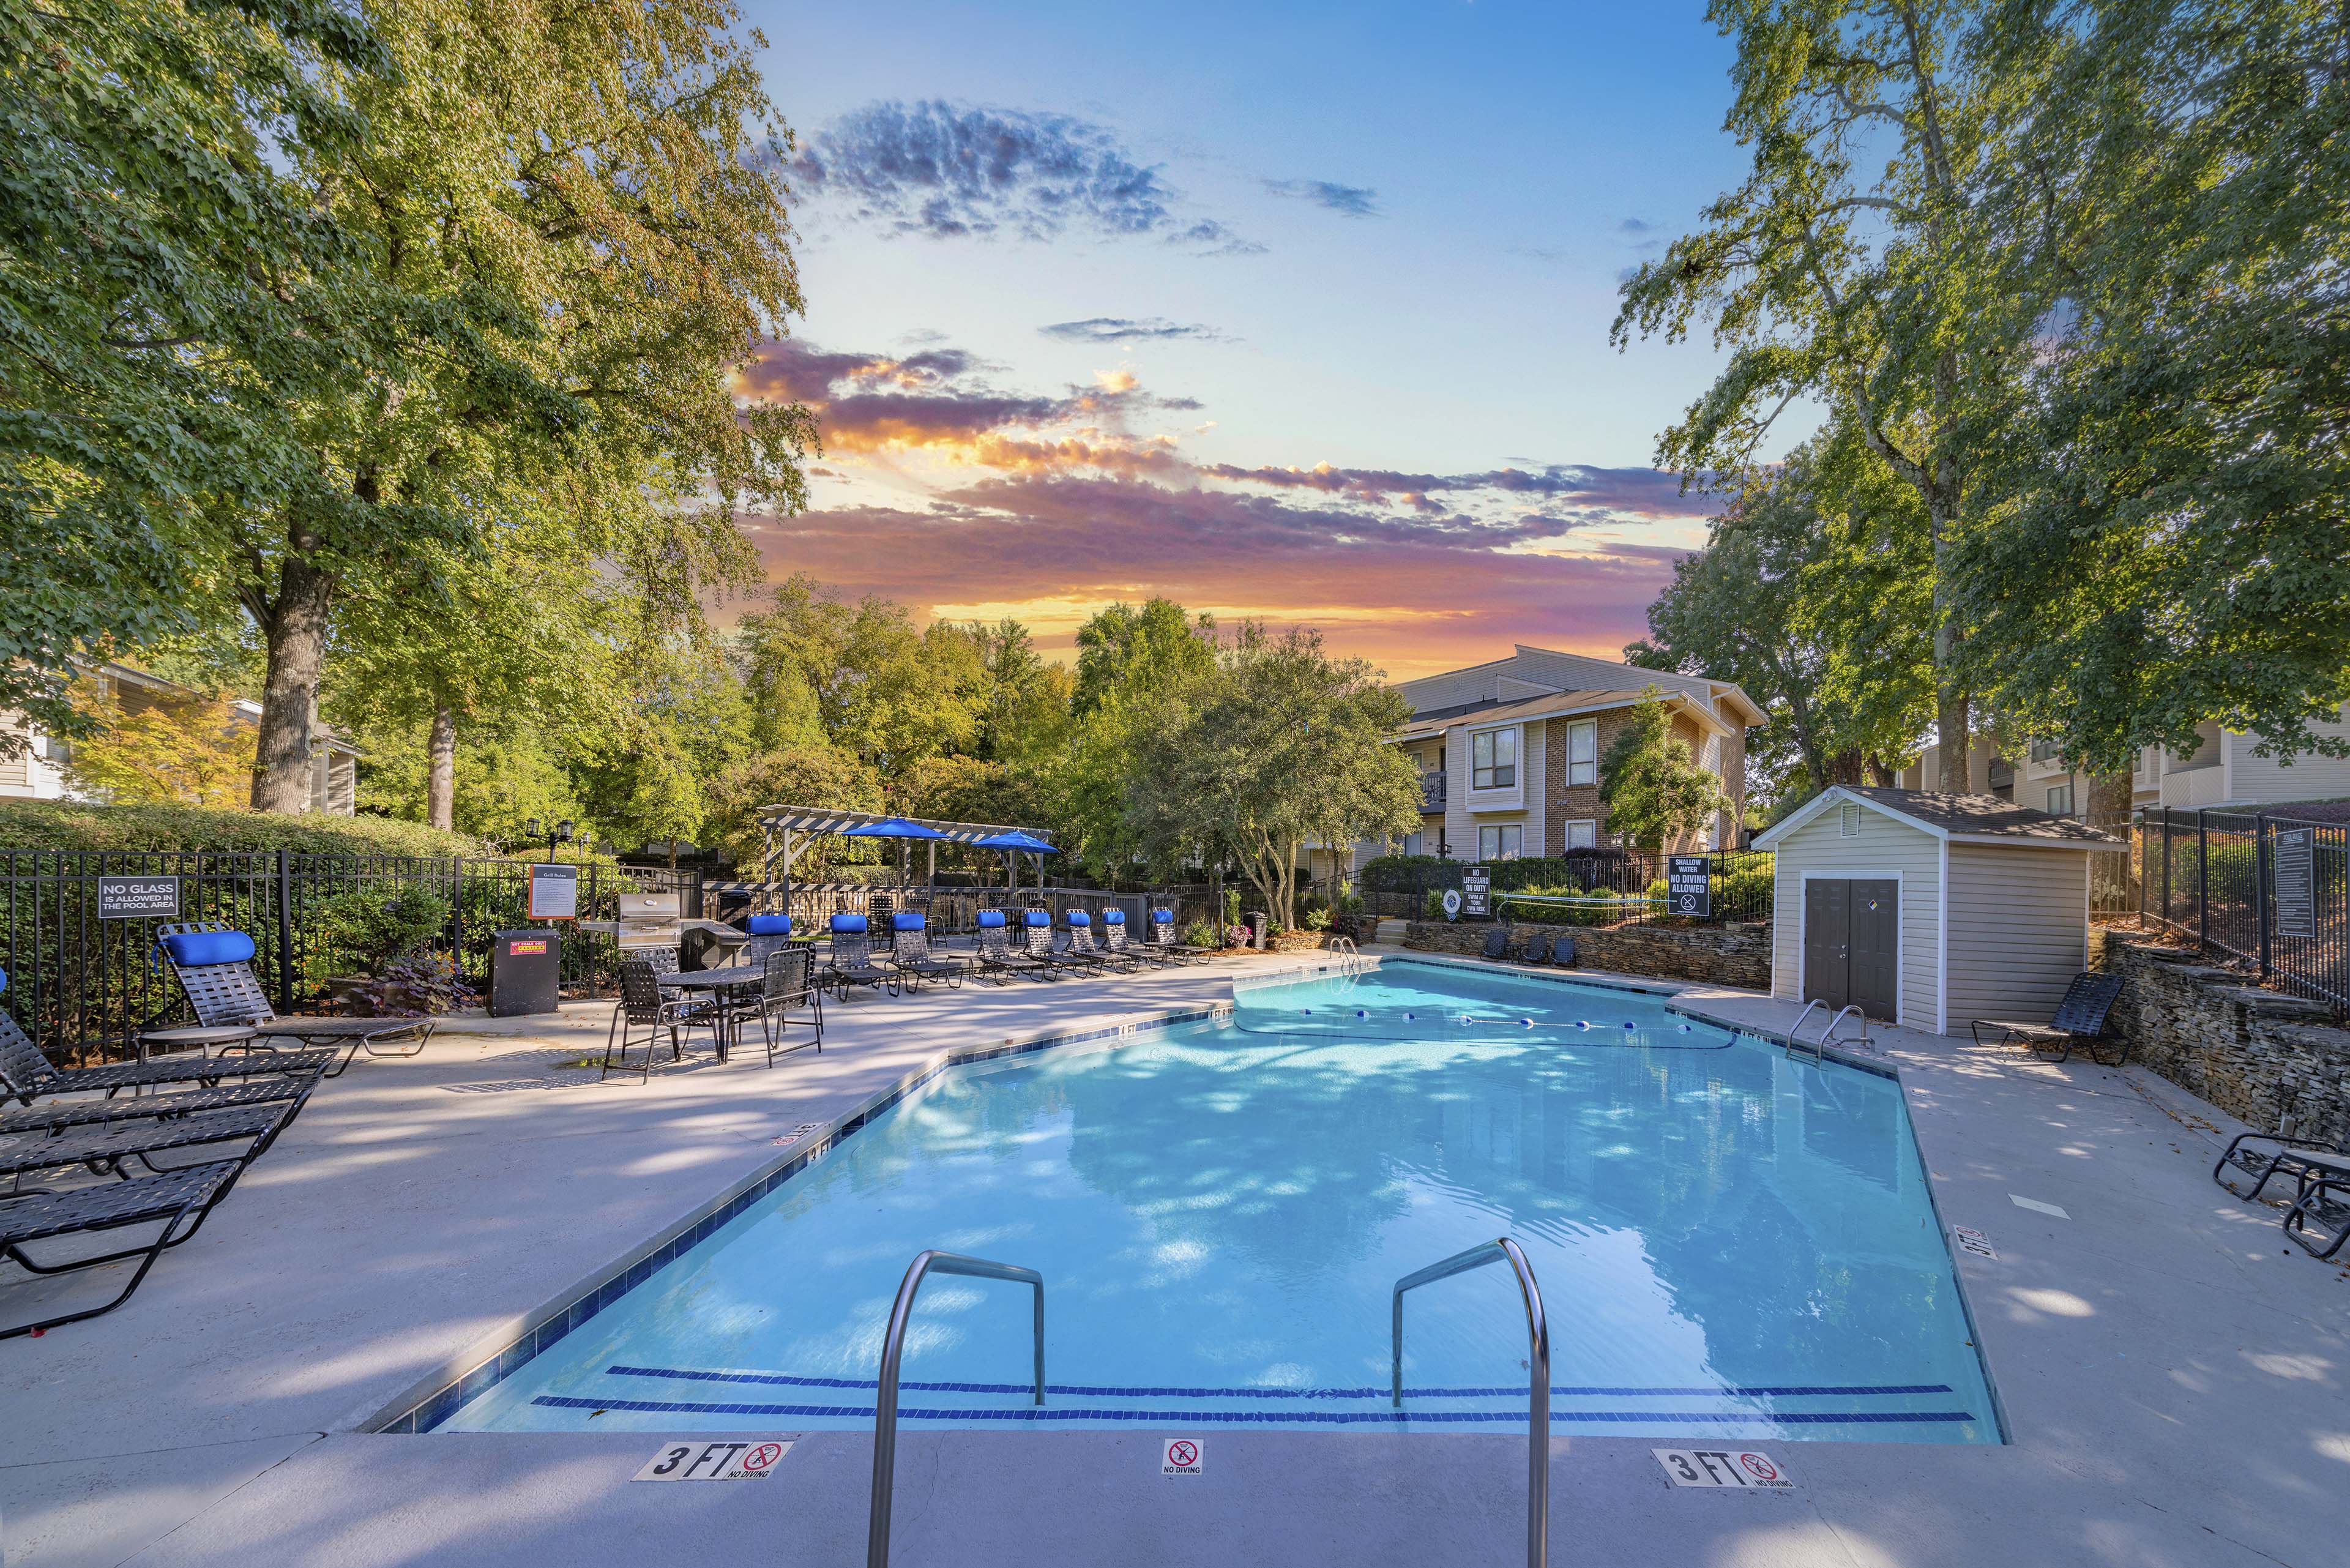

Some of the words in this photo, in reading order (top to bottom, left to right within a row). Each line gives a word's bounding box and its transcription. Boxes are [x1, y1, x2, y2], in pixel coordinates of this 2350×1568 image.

[1671, 874, 1680, 883] NO
[1682, 875, 1707, 884] DIVING
[103, 885, 126, 894] NO
[129, 884, 174, 894] GLASS
[1672, 884, 1705, 894] ALLOWED
[1128, 1024, 1135, 1033] FT
[811, 1148, 816, 1162] 3
[820, 1138, 831, 1156] FT
[1958, 1233, 1992, 1250] FT
[1964, 1245, 1991, 1255] 3
[653, 1447, 690, 1475] 3
[682, 1443, 750, 1478] FT
[1668, 1454, 1699, 1481] 3
[1693, 1452, 1747, 1486] FT
[727, 1470, 740, 1479] NO
[740, 1470, 770, 1479] DIVING
[1767, 1479, 1793, 1488] DIVING
